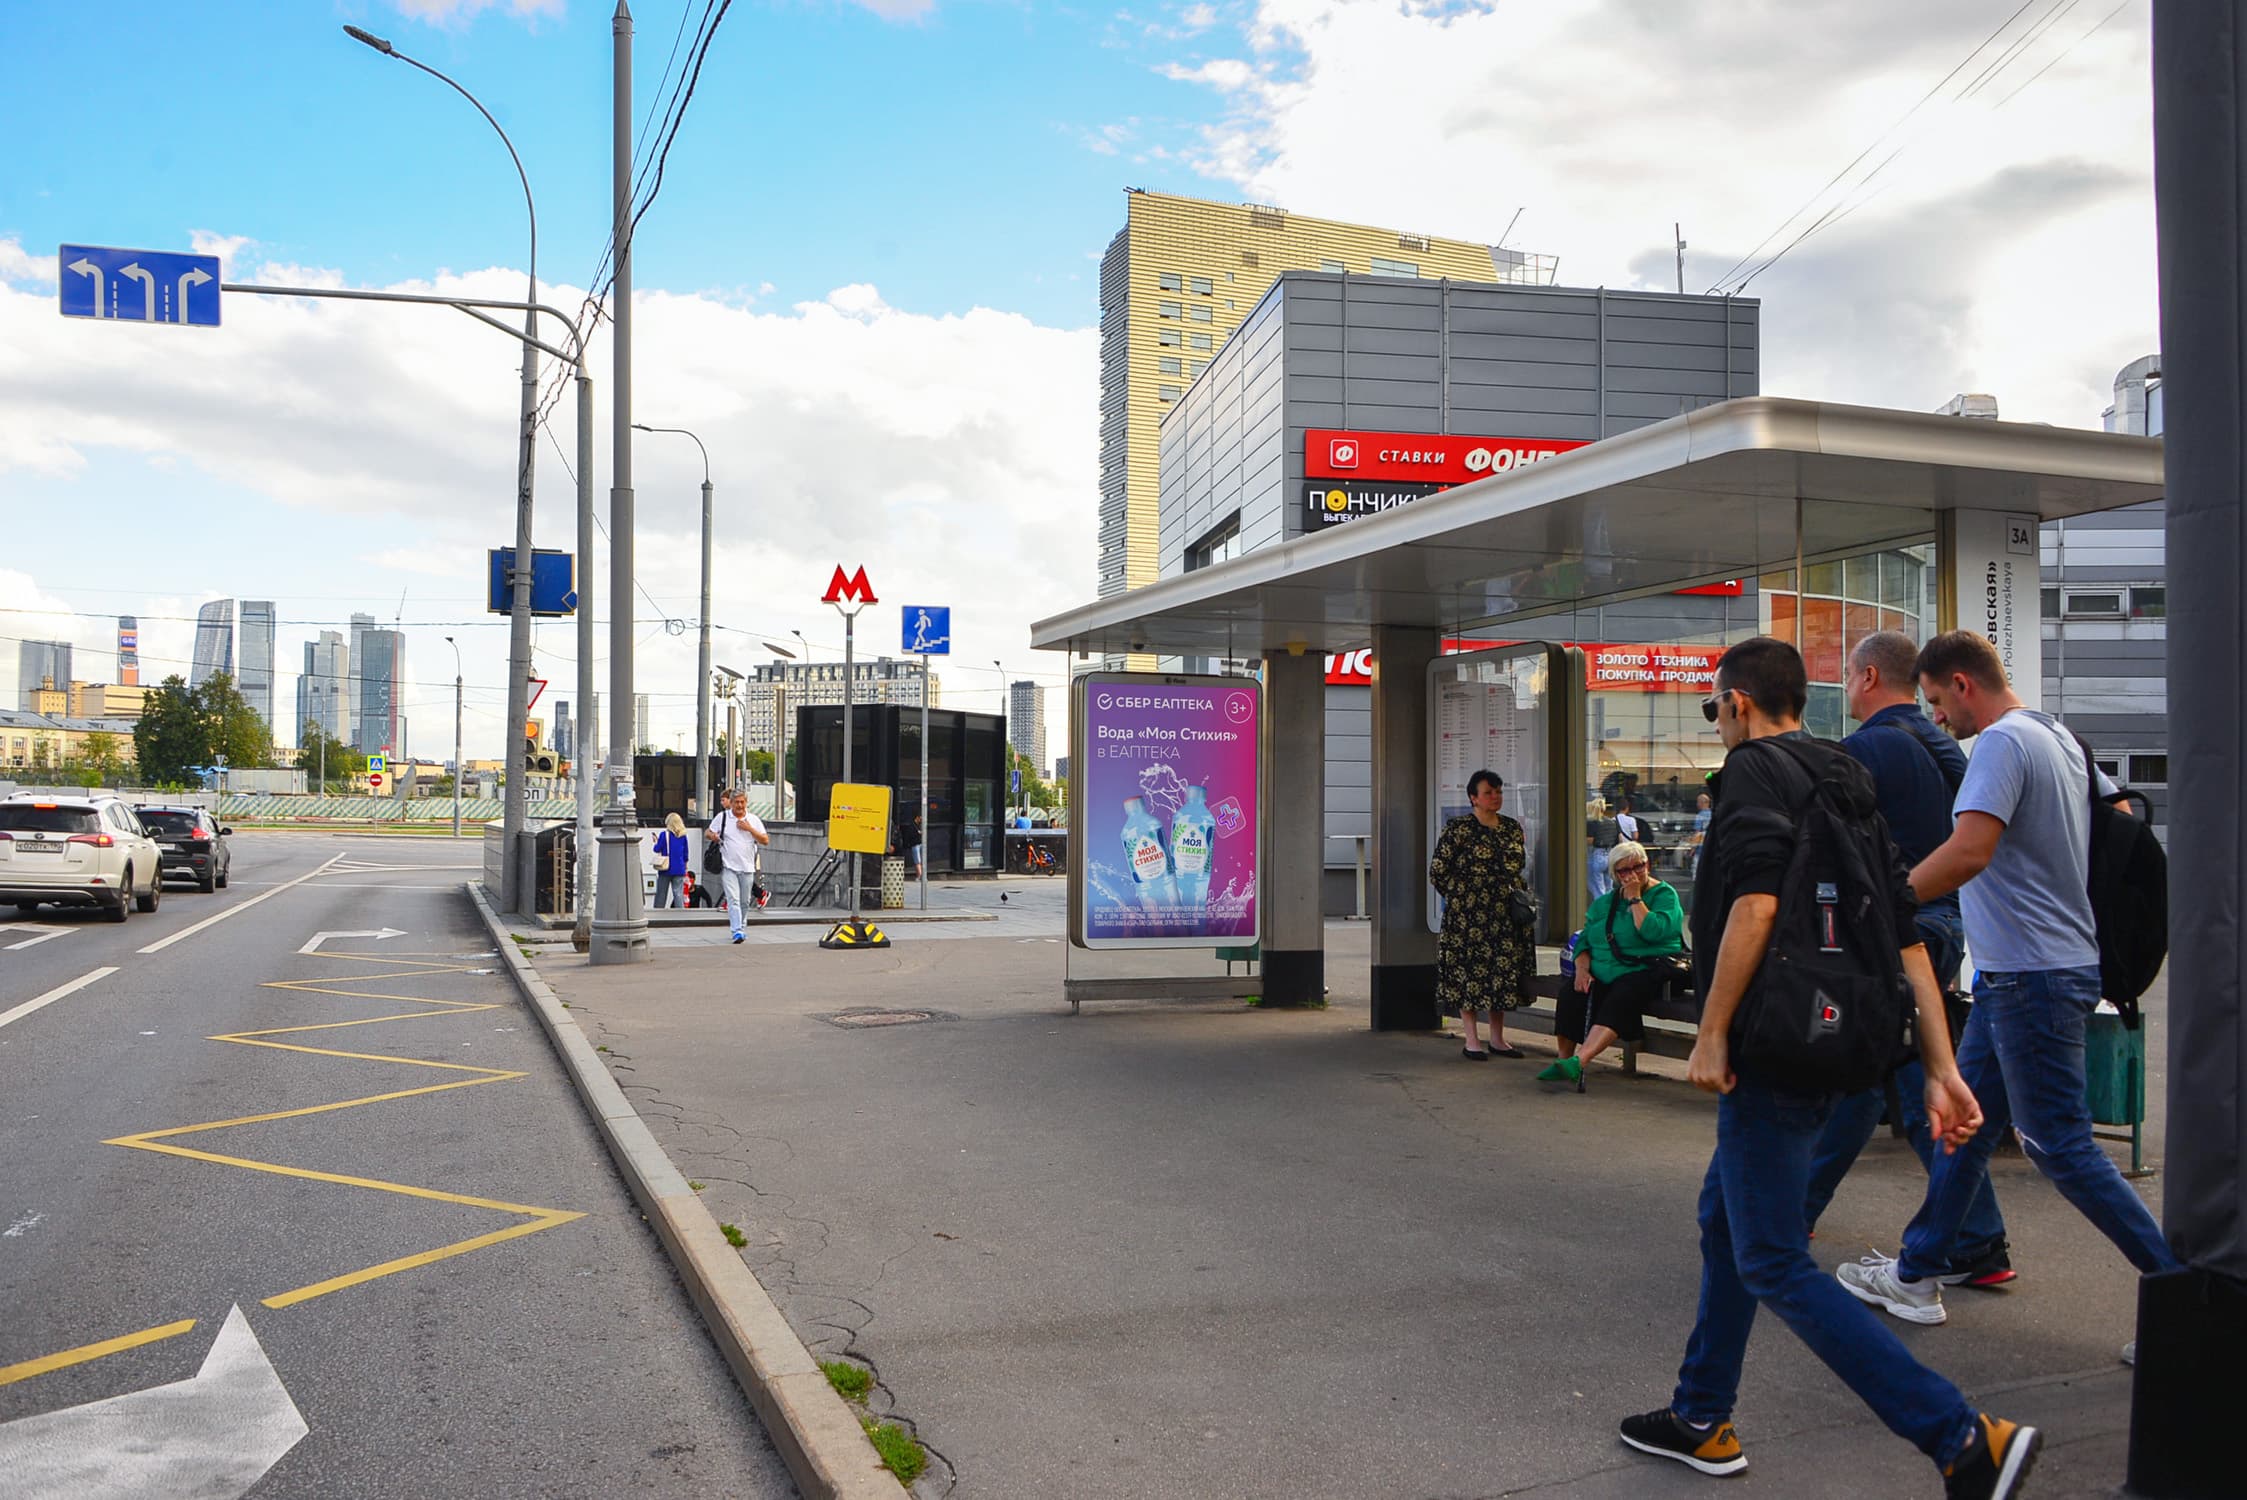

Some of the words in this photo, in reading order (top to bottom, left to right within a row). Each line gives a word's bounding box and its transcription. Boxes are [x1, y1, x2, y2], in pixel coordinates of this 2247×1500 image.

[1379, 449, 1445, 464] СТАВКИ
[1309, 489, 1416, 511] ПОНЧИК
[1986, 561, 1997, 649] евская»
[2002, 562, 2013, 667] Polezhaevskaya
[1596, 653, 1649, 666] ЗОЛОТО
[1653, 655, 1709, 668] ТЕХНИКА
[1596, 669, 1655, 681] ПОКУПКА
[1660, 671, 1715, 684] ПРОДАЖ
[1116, 696, 1151, 709] СБЕР
[1153, 698, 1214, 711] ЕАПТЕКА
[1230, 701, 1247, 714] 3+
[1097, 725, 1134, 740] Вода
[1138, 726, 1176, 740] «Моя
[1180, 727, 1238, 741] Стихия»
[1097, 747, 1106, 758] в
[1109, 745, 1181, 759] ЕАПТЕКА
[1182, 838, 1202, 847] МОЯ
[1137, 845, 1157, 857] МОЯ
[1176, 846, 1206, 855] СТИХИЯ
[1135, 851, 1165, 866] СТИХИЯ
